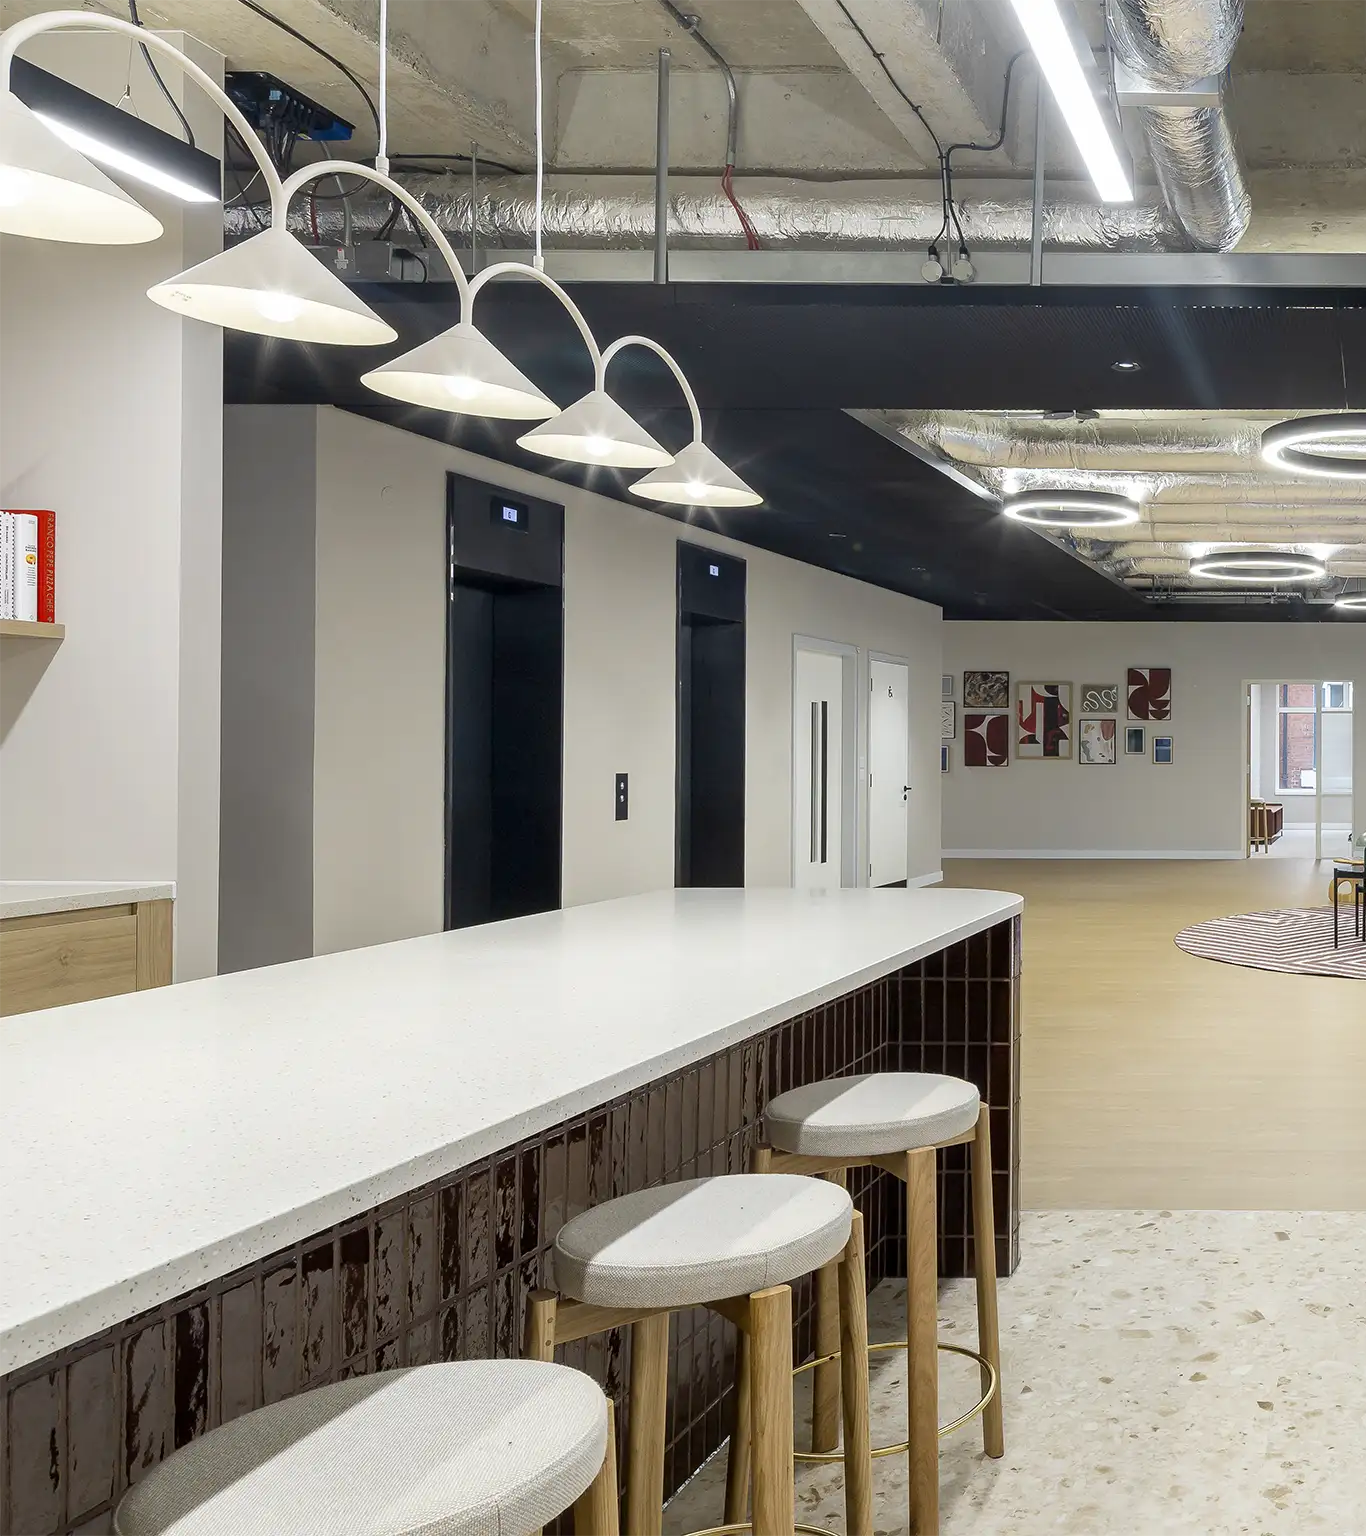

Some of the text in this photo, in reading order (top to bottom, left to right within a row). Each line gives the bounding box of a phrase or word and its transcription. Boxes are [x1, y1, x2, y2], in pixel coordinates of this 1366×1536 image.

[46, 513, 54, 613] FRANCO PEPE PIZZA CHEF
